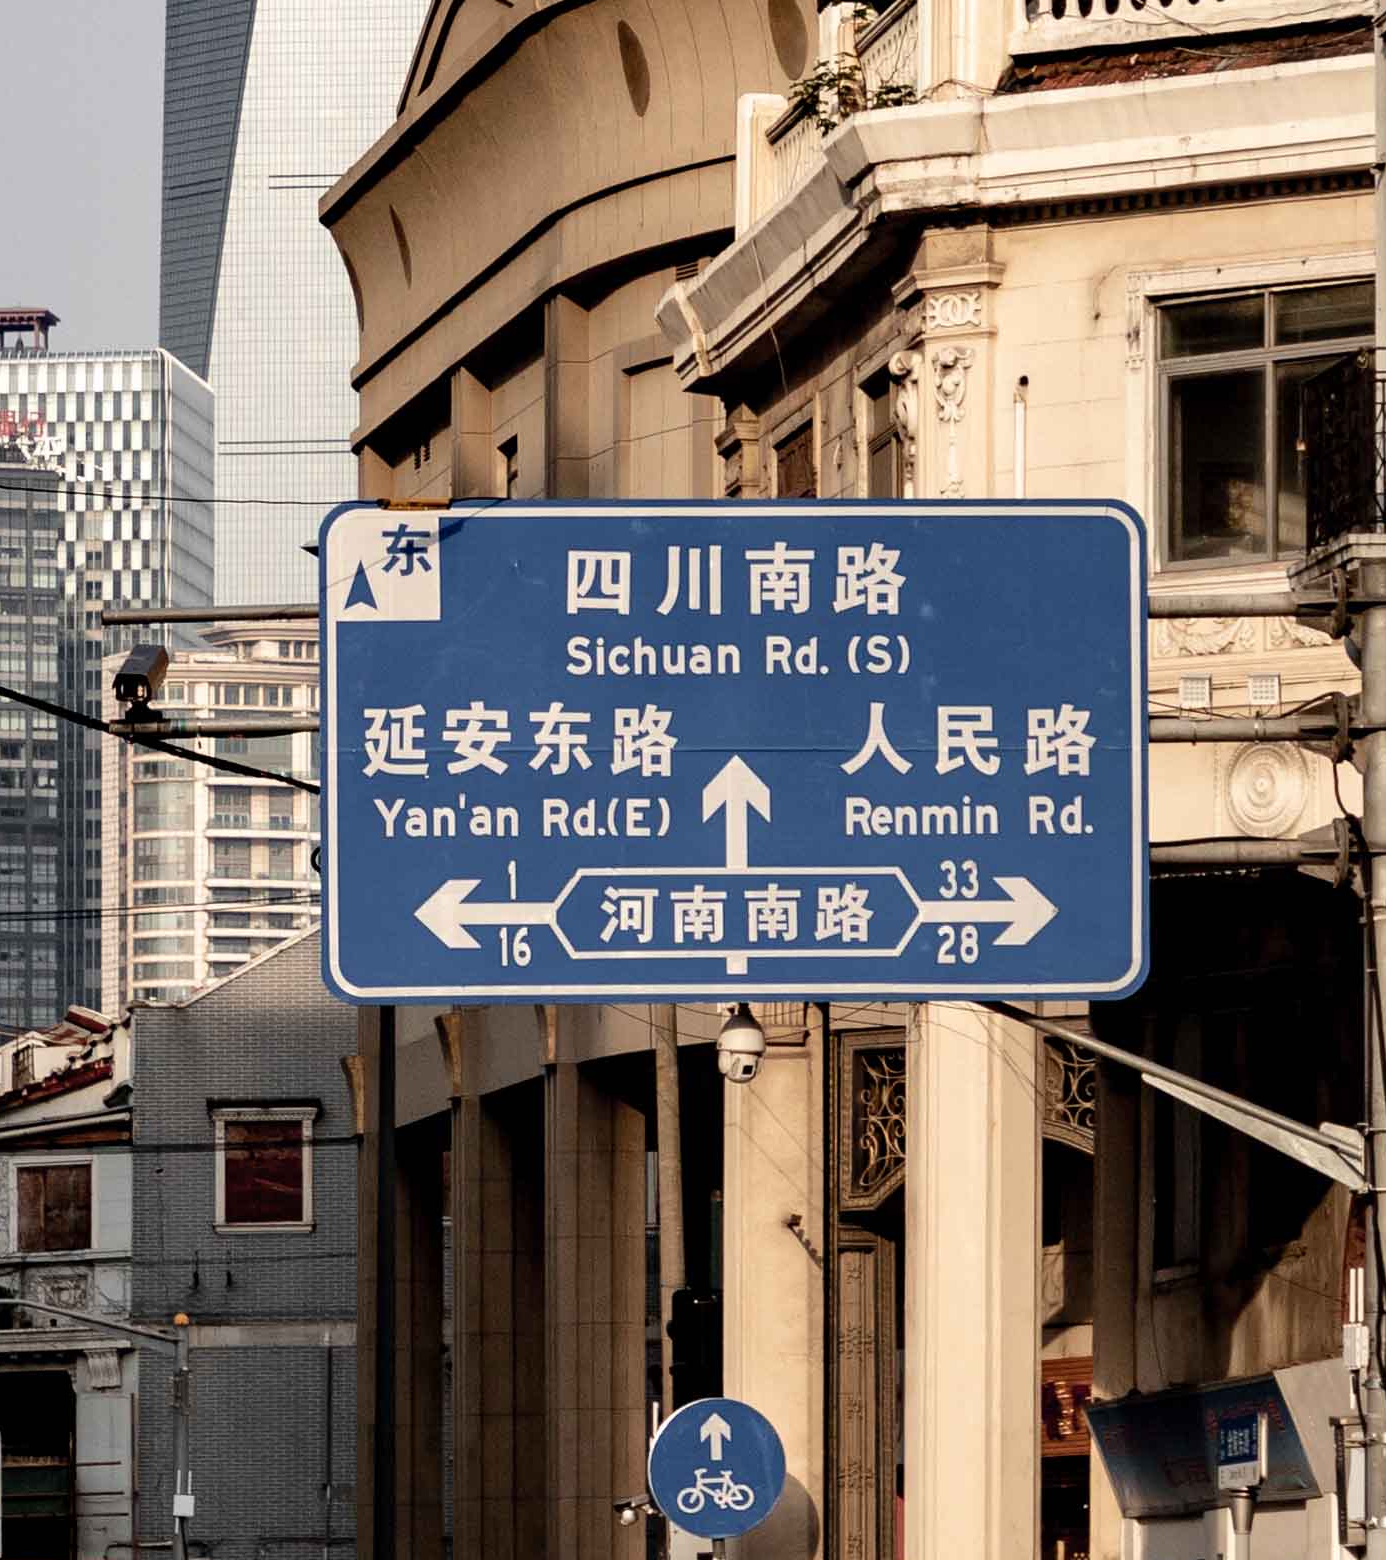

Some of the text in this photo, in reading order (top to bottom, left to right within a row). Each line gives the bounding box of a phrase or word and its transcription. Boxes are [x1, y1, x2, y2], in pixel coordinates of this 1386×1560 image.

[382, 524, 432, 576] 东
[566, 541, 907, 616] 四川南路
[566, 635, 911, 676] Sichuan Rd. (S)
[362, 701, 678, 779] 延安东路
[840, 702, 1097, 777] 人民路
[373, 793, 519, 838] Yan'an
[845, 795, 1095, 836] Renmin Rd.
[507, 861, 517, 900] 1
[939, 860, 979, 899] 33
[599, 883, 877, 945] 河南南路
[500, 926, 532, 969] 16
[937, 925, 979, 965] 28
